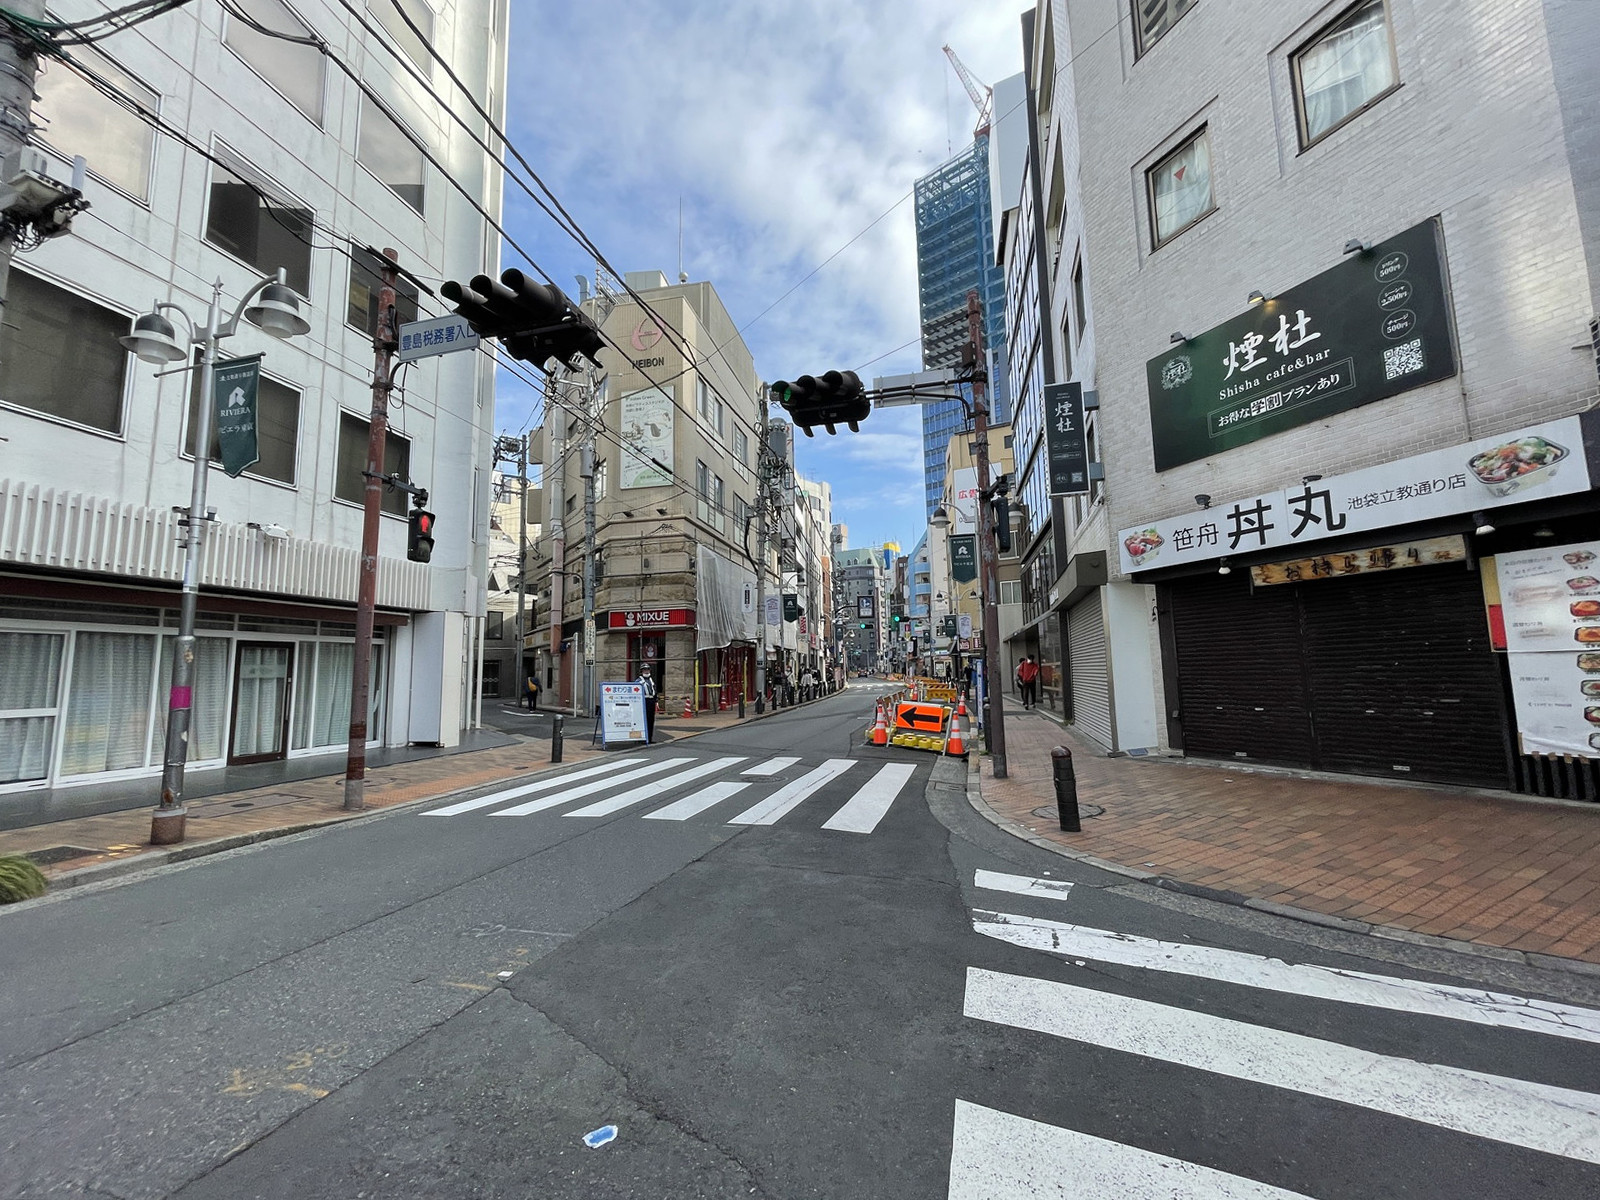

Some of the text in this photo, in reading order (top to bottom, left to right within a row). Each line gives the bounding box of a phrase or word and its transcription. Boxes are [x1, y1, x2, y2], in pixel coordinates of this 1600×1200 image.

[1222, 309, 1322, 381] 煙杜
[632, 357, 665, 369] HEIBON
[1219, 348, 1331, 401] Shisha cafe&bar
[220, 407, 251, 417] RIVIERA
[1217, 373, 1341, 427] お得な学割プランあり
[1054, 401, 1075, 433] 煙杜
[1172, 473, 1467, 553] 笹舟 丼丸 池袋立教通り店
[637, 611, 670, 622] MIXUE
[612, 686, 632, 694] まわり道
